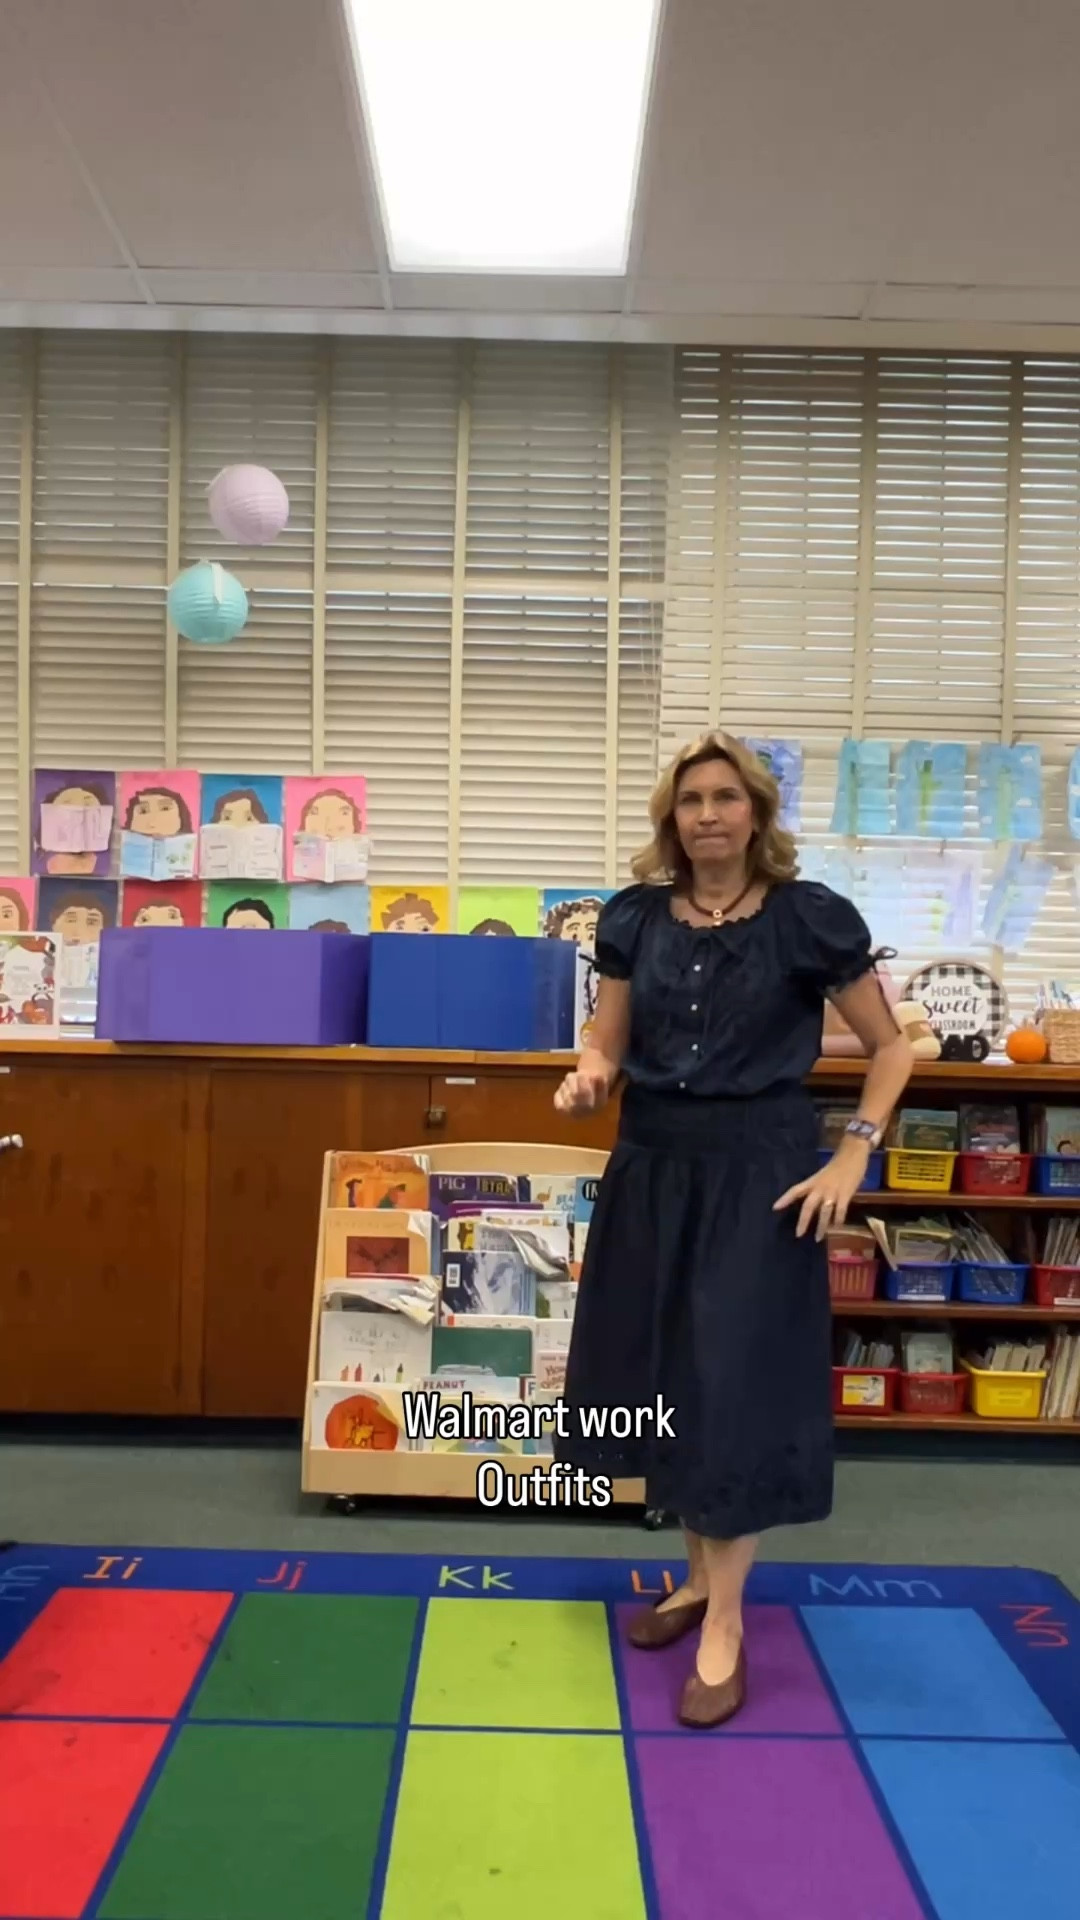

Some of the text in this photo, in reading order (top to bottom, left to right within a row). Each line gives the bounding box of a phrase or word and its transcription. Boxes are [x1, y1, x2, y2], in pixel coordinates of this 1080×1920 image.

[931, 986, 972, 997] HOME
[922, 997, 981, 1019] sweet
[438, 1176, 466, 1190] PIG
[423, 1380, 465, 1390] PEANUT
[82, 1556, 143, 1580] Ii
[256, 1561, 309, 1591] Jj
[439, 1565, 515, 1590] Kk
[809, 1574, 942, 1599] Mm
